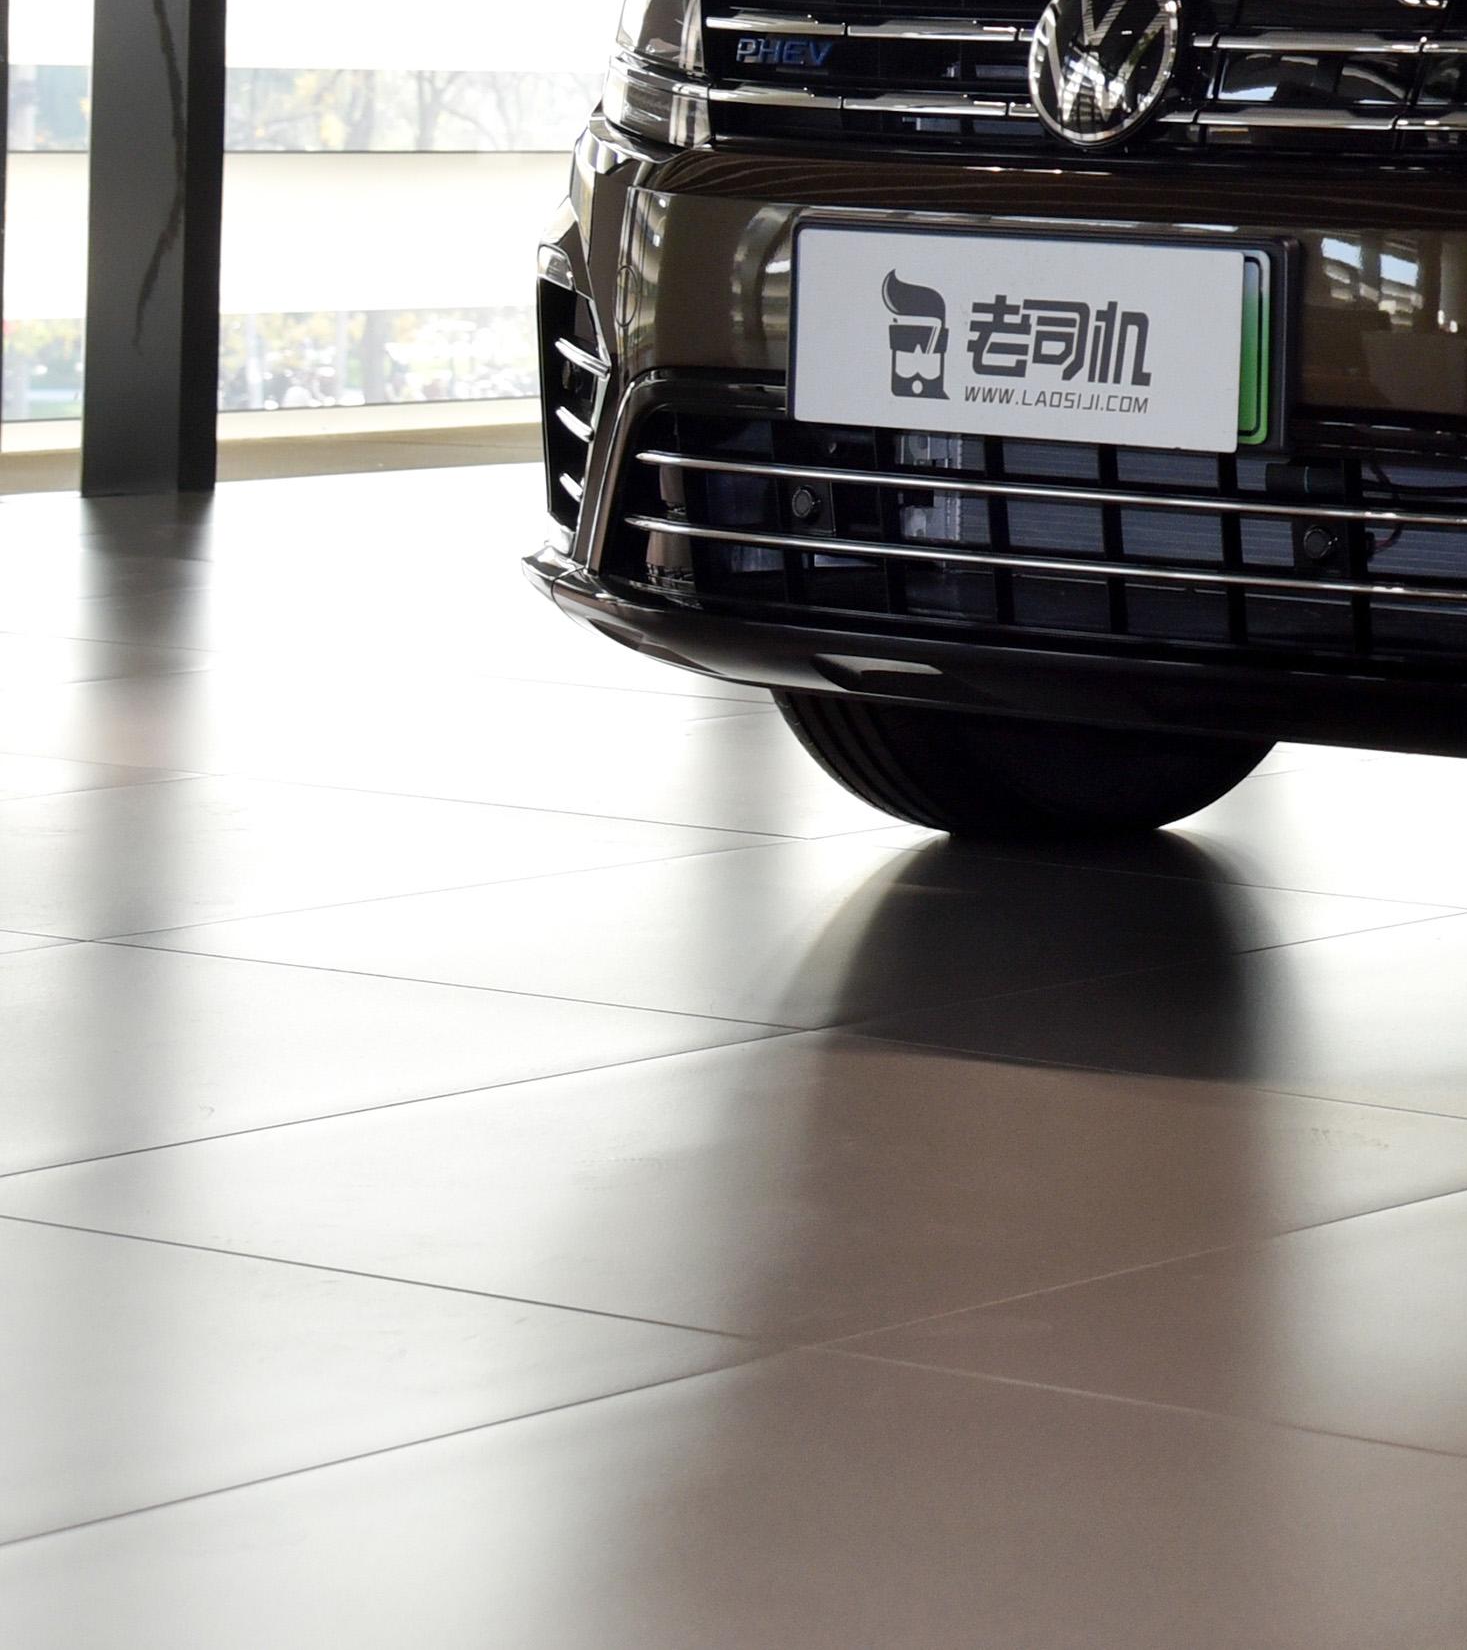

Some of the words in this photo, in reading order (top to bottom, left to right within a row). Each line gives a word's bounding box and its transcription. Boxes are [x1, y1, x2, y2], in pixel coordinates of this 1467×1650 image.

[735, 37, 834, 67] PHEV
[966, 293, 1154, 387] 老司机
[963, 384, 1151, 416] WWW.LAOSIJI.COM
